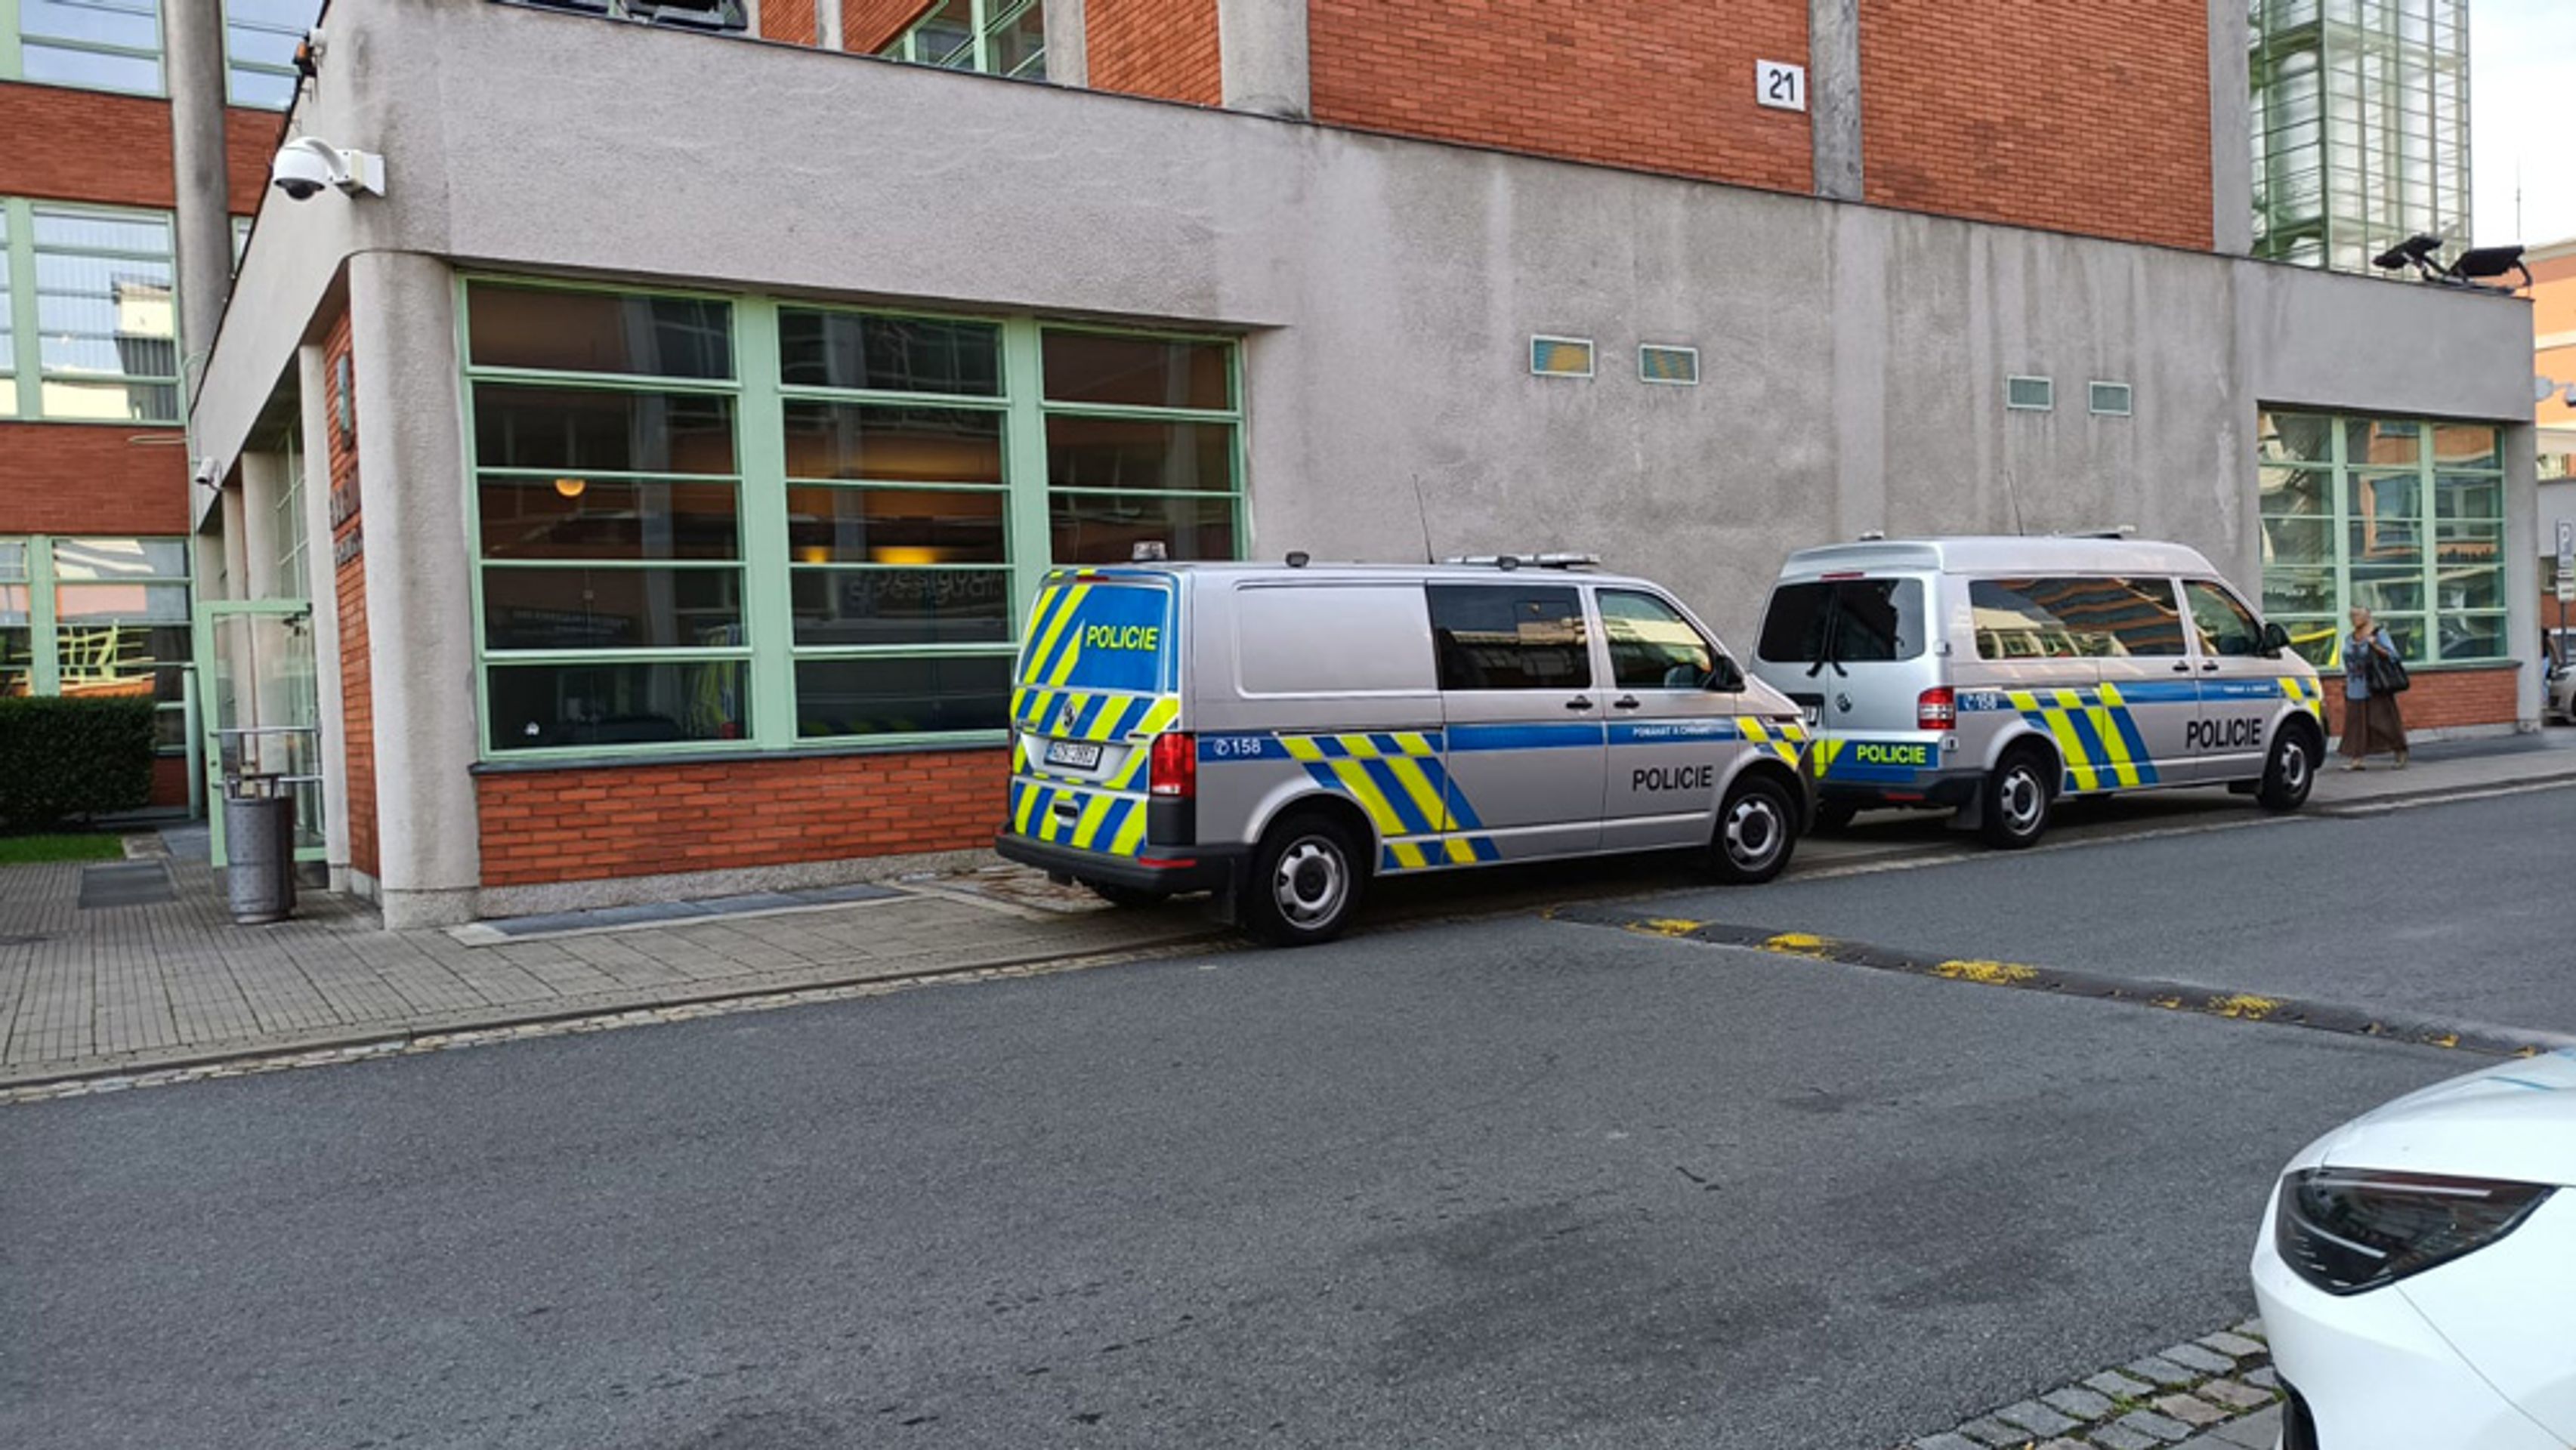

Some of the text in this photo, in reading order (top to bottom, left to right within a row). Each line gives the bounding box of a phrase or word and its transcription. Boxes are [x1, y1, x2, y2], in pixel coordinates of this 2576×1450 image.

[1769, 69, 1794, 102] 21
[1086, 625, 1159, 650] POLICIE
[1978, 693, 1997, 711] 158
[2185, 718, 2262, 748] POLICIE
[1232, 737, 1262, 755] 158
[1857, 744, 1926, 764] POLICIE
[1633, 765, 1713, 791] POLICIE
